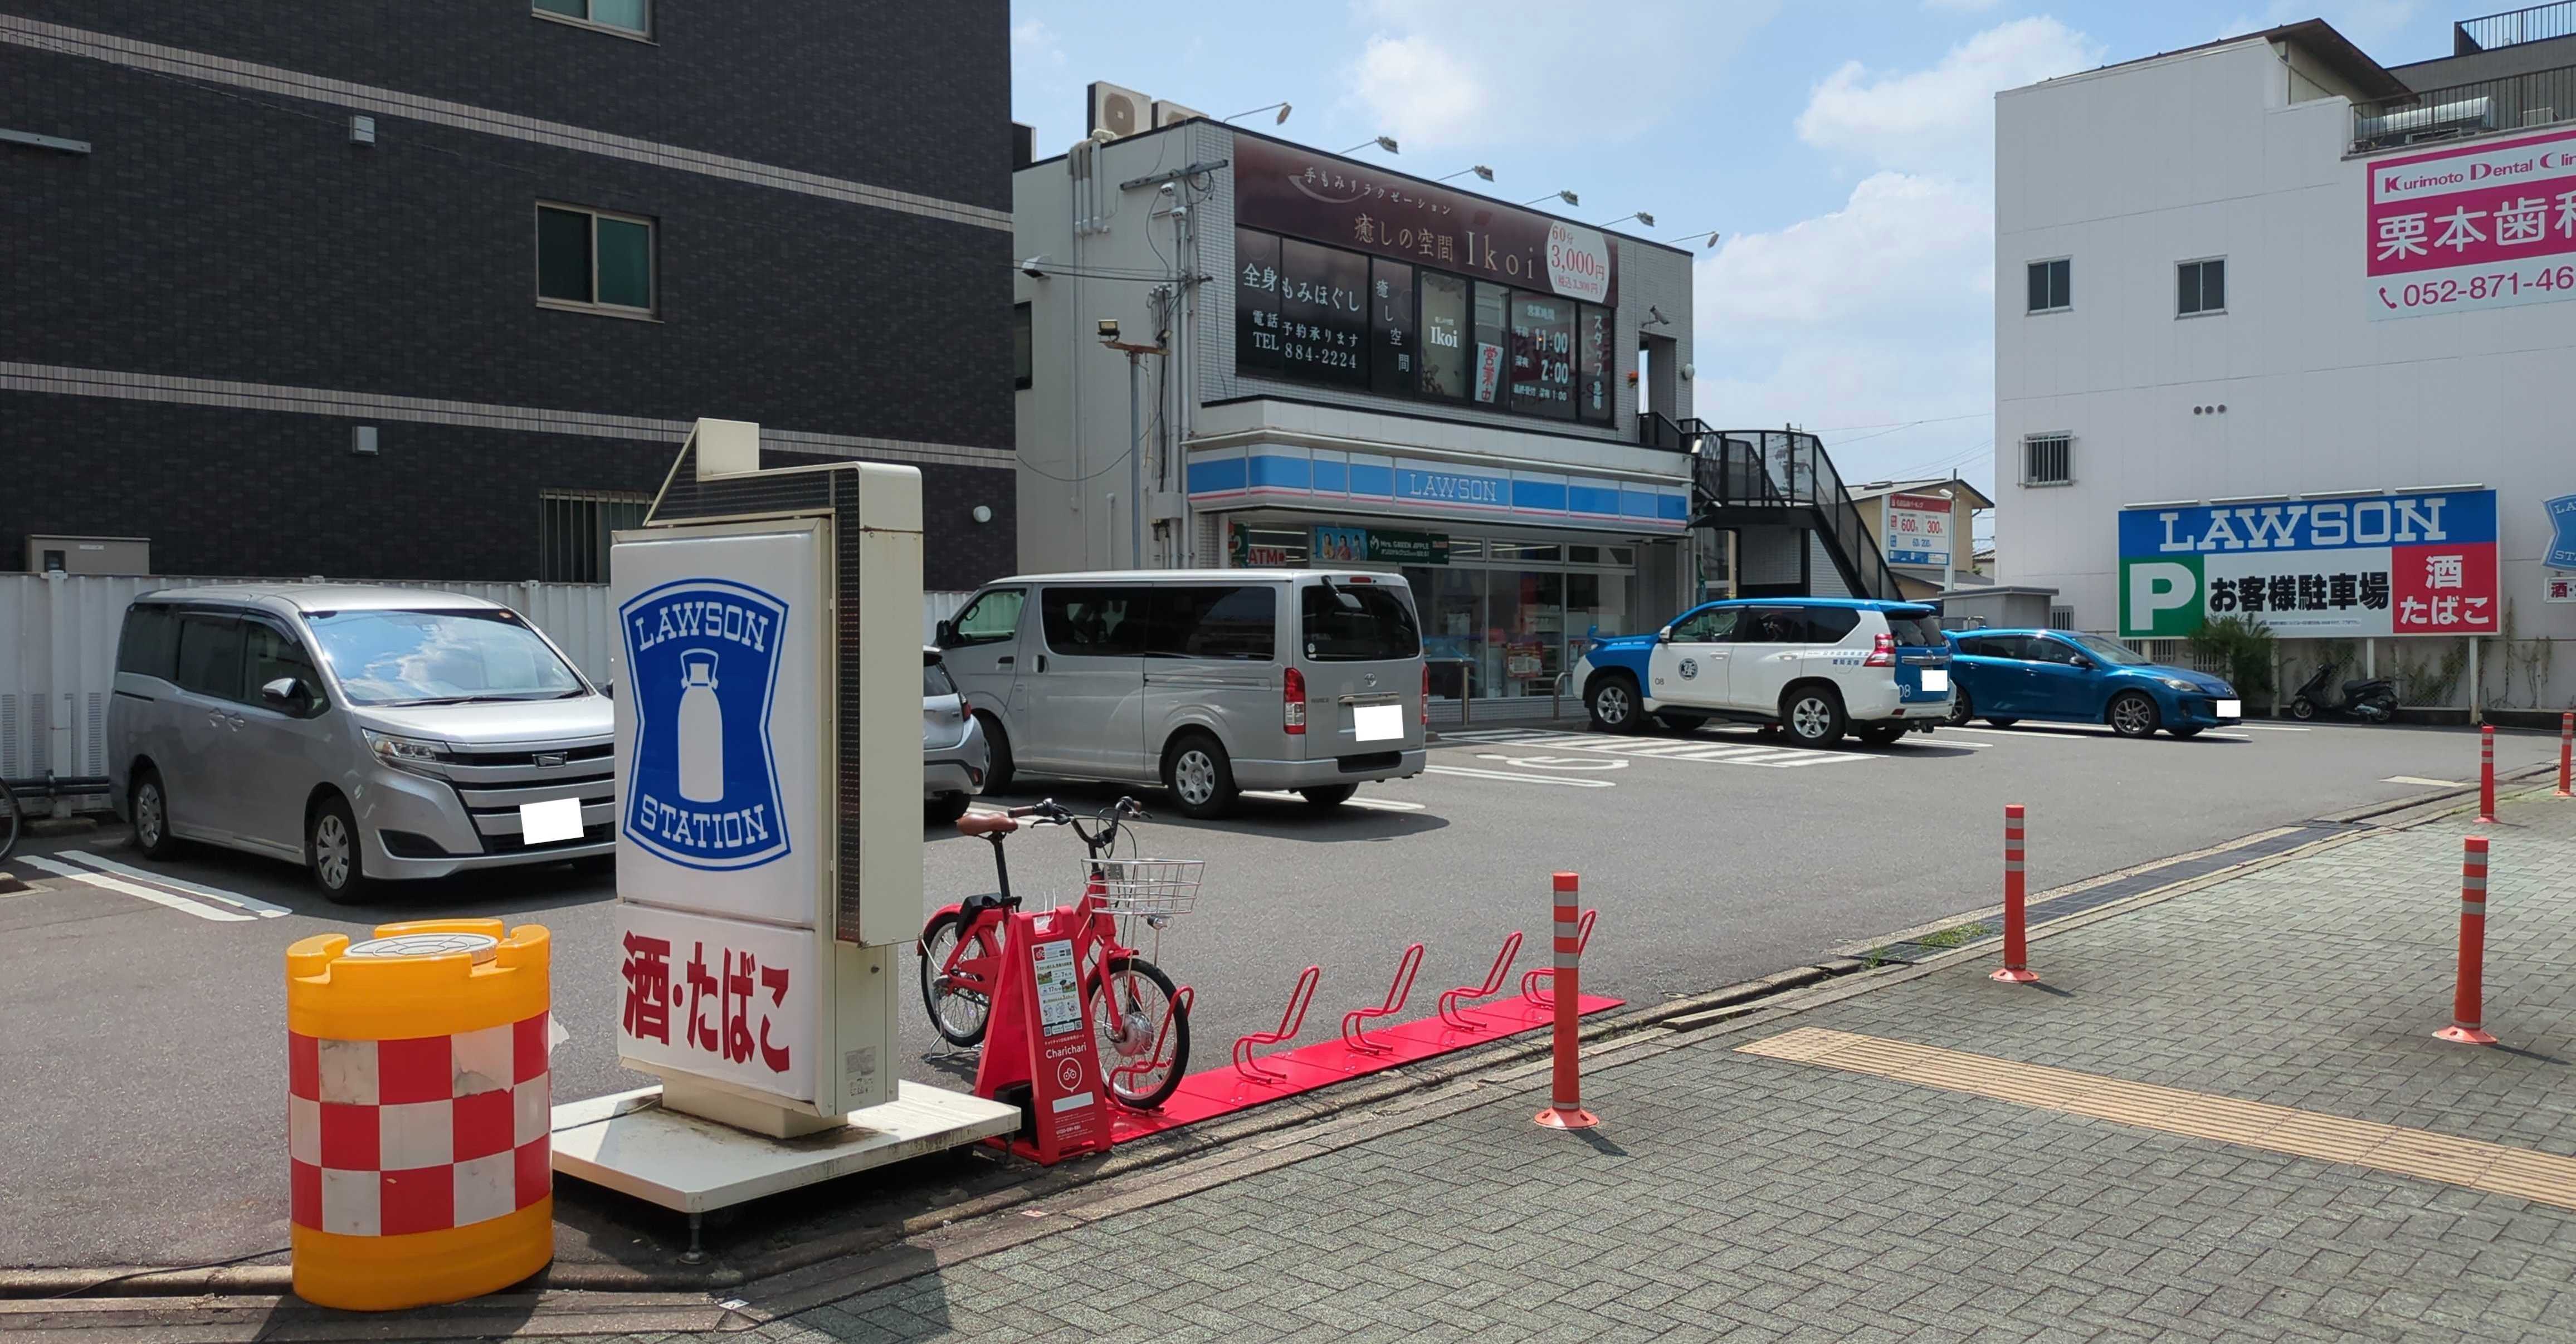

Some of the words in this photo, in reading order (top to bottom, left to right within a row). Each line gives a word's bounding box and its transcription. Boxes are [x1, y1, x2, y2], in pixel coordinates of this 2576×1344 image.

[1304, 167, 1451, 214] 手もみリラクゼーション
[2385, 174, 2463, 193] Kurimoto
[2470, 159, 2533, 180] Dental
[1354, 213, 1453, 262] 癒しの空間
[1466, 231, 1533, 279] Ikoi
[1552, 226, 1574, 245] 60分
[1552, 245, 1605, 281] 3,000円
[1243, 263, 1360, 311] 全身もみほぐし
[1253, 310, 1358, 347] 電話予約承ります
[1431, 326, 1458, 348] Ikoi
[1535, 328, 1568, 354] 11:00
[1253, 332, 1280, 351] TEL
[1285, 343, 1357, 369] 884-2224
[1482, 346, 1498, 402] 営業中
[1541, 359, 1568, 384] 2:00
[1409, 472, 1497, 502] LAWSON
[2159, 497, 2447, 552] LAWSON
[1249, 548, 1278, 565] ATM
[2426, 555, 2463, 589] 酒
[2130, 562, 2197, 631] P
[2209, 572, 2390, 613] お客様駐車場
[2400, 595, 2490, 625] たばこ
[635, 602, 769, 653] LAWSON
[640, 794, 768, 848] STATION
[623, 929, 791, 1074] 酒・たばこ
[1046, 1042, 1087, 1059] Charichari
